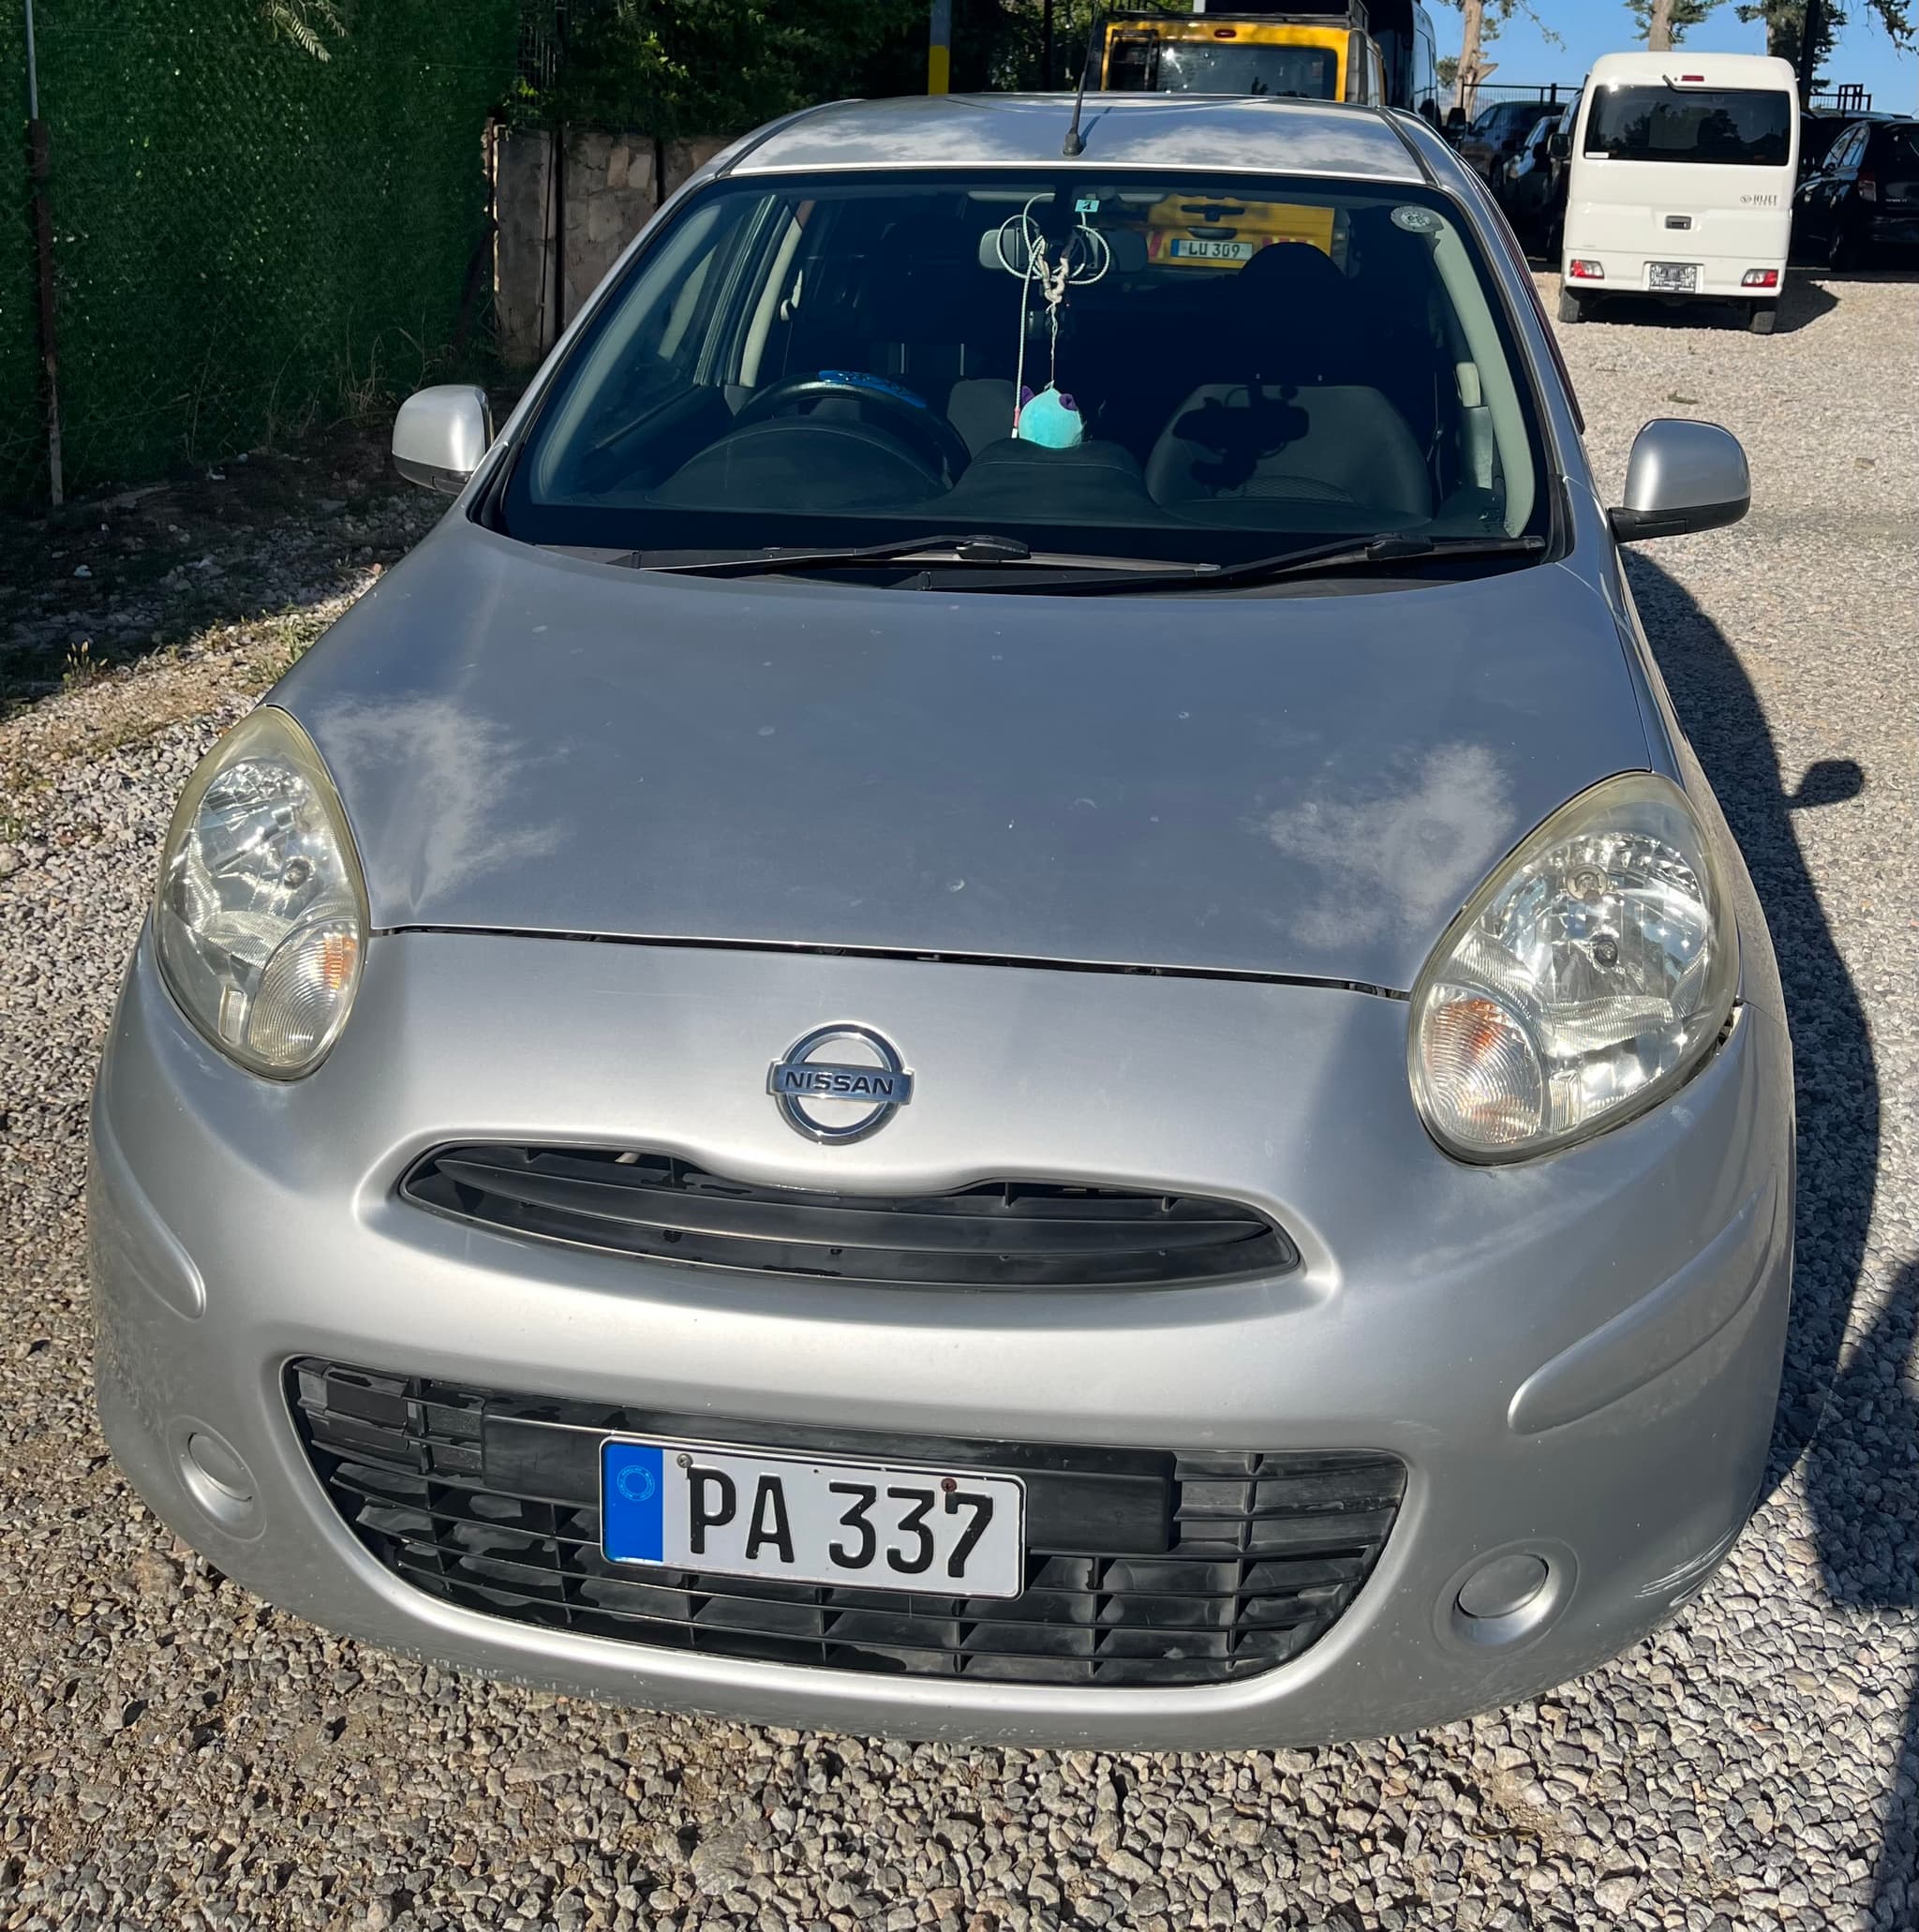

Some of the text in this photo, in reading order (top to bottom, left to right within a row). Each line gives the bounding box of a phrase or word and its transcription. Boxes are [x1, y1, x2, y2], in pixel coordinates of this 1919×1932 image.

[1188, 242, 1241, 258] LU 309
[785, 1071, 894, 1096] NISSAN
[687, 1464, 994, 1579] PA 337
